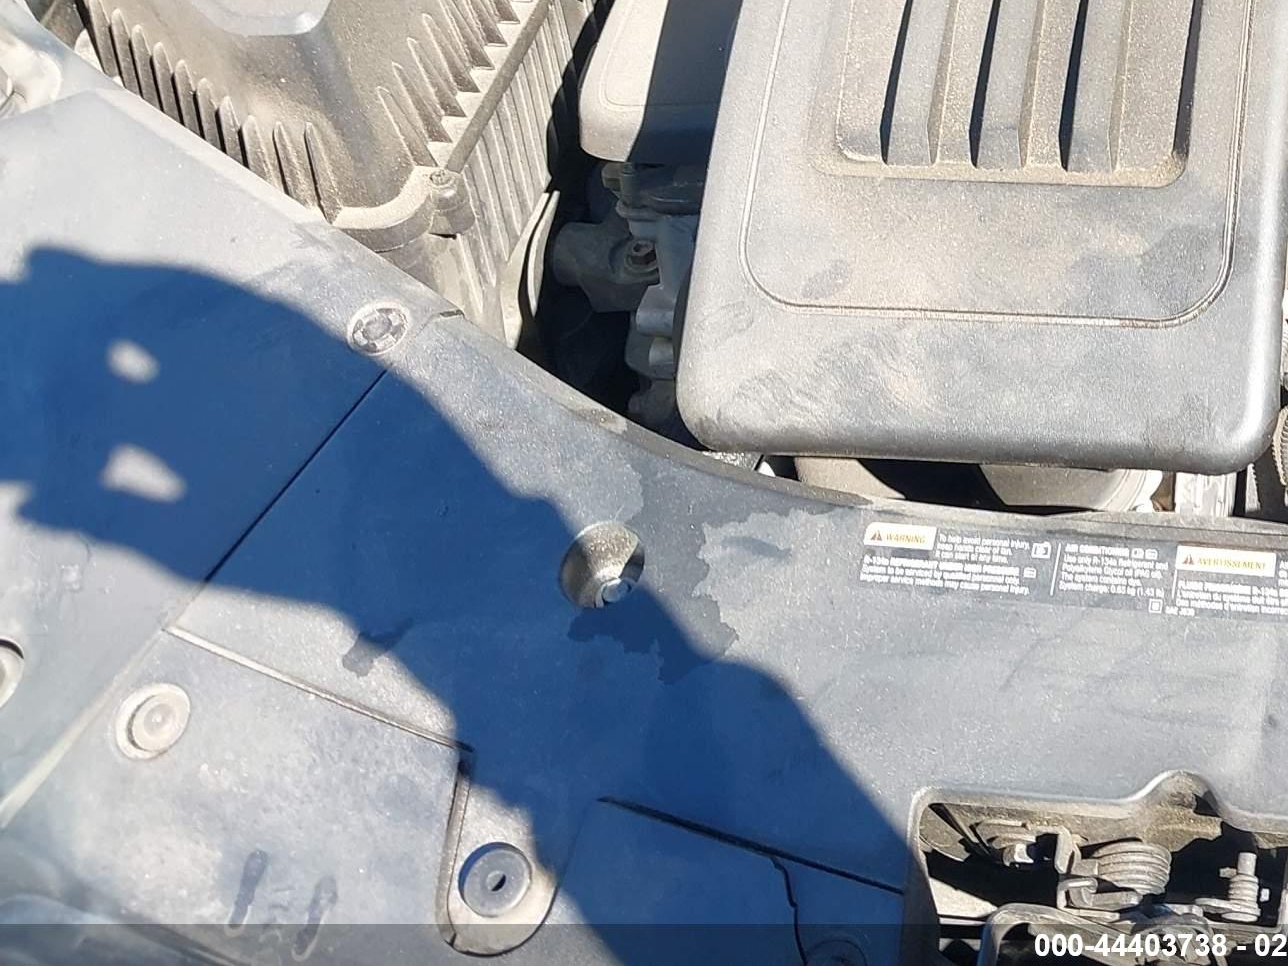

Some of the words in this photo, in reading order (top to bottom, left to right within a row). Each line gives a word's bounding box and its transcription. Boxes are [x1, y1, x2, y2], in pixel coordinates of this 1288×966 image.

[886, 530, 926, 544] WARNING
[940, 533, 947, 542] To
[949, 534, 962, 545] help
[963, 535, 980, 545] avoid
[982, 536, 1010, 548] personal
[954, 543, 973, 553] hands
[975, 544, 991, 554] clear
[1065, 543, 1078, 553] AIR
[941, 551, 953, 559] can
[954, 551, 969, 561] start
[979, 554, 991, 563] any
[1064, 553, 1077, 564] Use
[1078, 554, 1091, 565] only
[1092, 555, 1117, 567] R-134a
[1118, 557, 1154, 570] Refrigerant
[1155, 561, 1169, 571] and
[1198, 556, 1266, 571] AVERTISSEMENT
[862, 563, 887, 575] System
[895, 566, 904, 576] be
[905, 567, 932, 578] serviced
[933, 570, 942, 580] by
[1062, 571, 1074, 581] The
[1074, 573, 1098, 584] system
[1099, 574, 1127, 586] contains
[1104, 566, 1124, 578] Glycol
[1124, 568, 1133, 577] oil
[860, 572, 889, 584] Improper
[890, 575, 914, 585] service
[915, 577, 944, 588] methods
[945, 580, 959, 591] may
[960, 581, 980, 590] cause
[980, 582, 1009, 593] personal
[1059, 580, 1083, 592] System
[1127, 585, 1137, 596] kg
